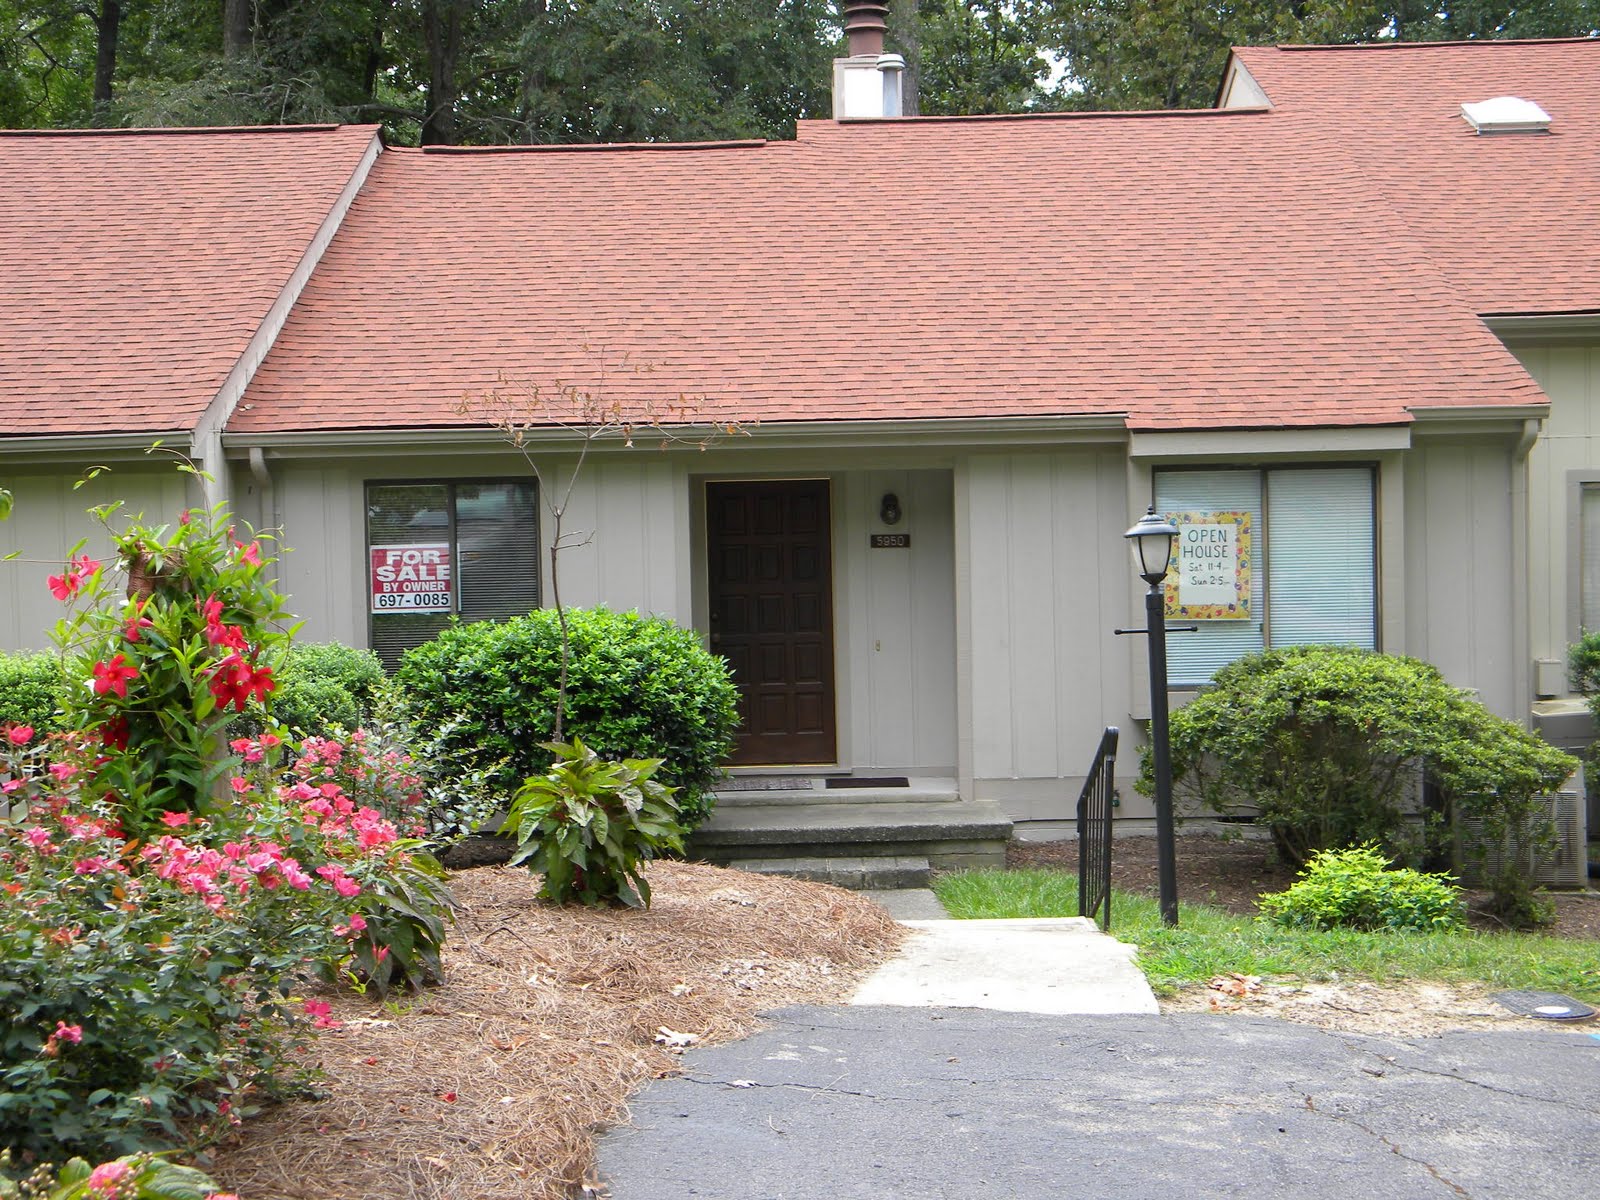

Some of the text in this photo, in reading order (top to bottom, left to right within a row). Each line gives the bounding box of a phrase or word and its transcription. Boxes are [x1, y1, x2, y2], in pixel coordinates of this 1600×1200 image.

[1188, 529, 1227, 543] OPEN
[386, 550, 441, 565] FOR
[1183, 545, 1228, 559] HOUSE
[376, 565, 450, 582] SALE
[1188, 562, 1203, 572] Sat
[383, 581, 446, 593] BY OWNER
[1191, 576, 1207, 586] Sun
[379, 594, 449, 607] 697-0085
